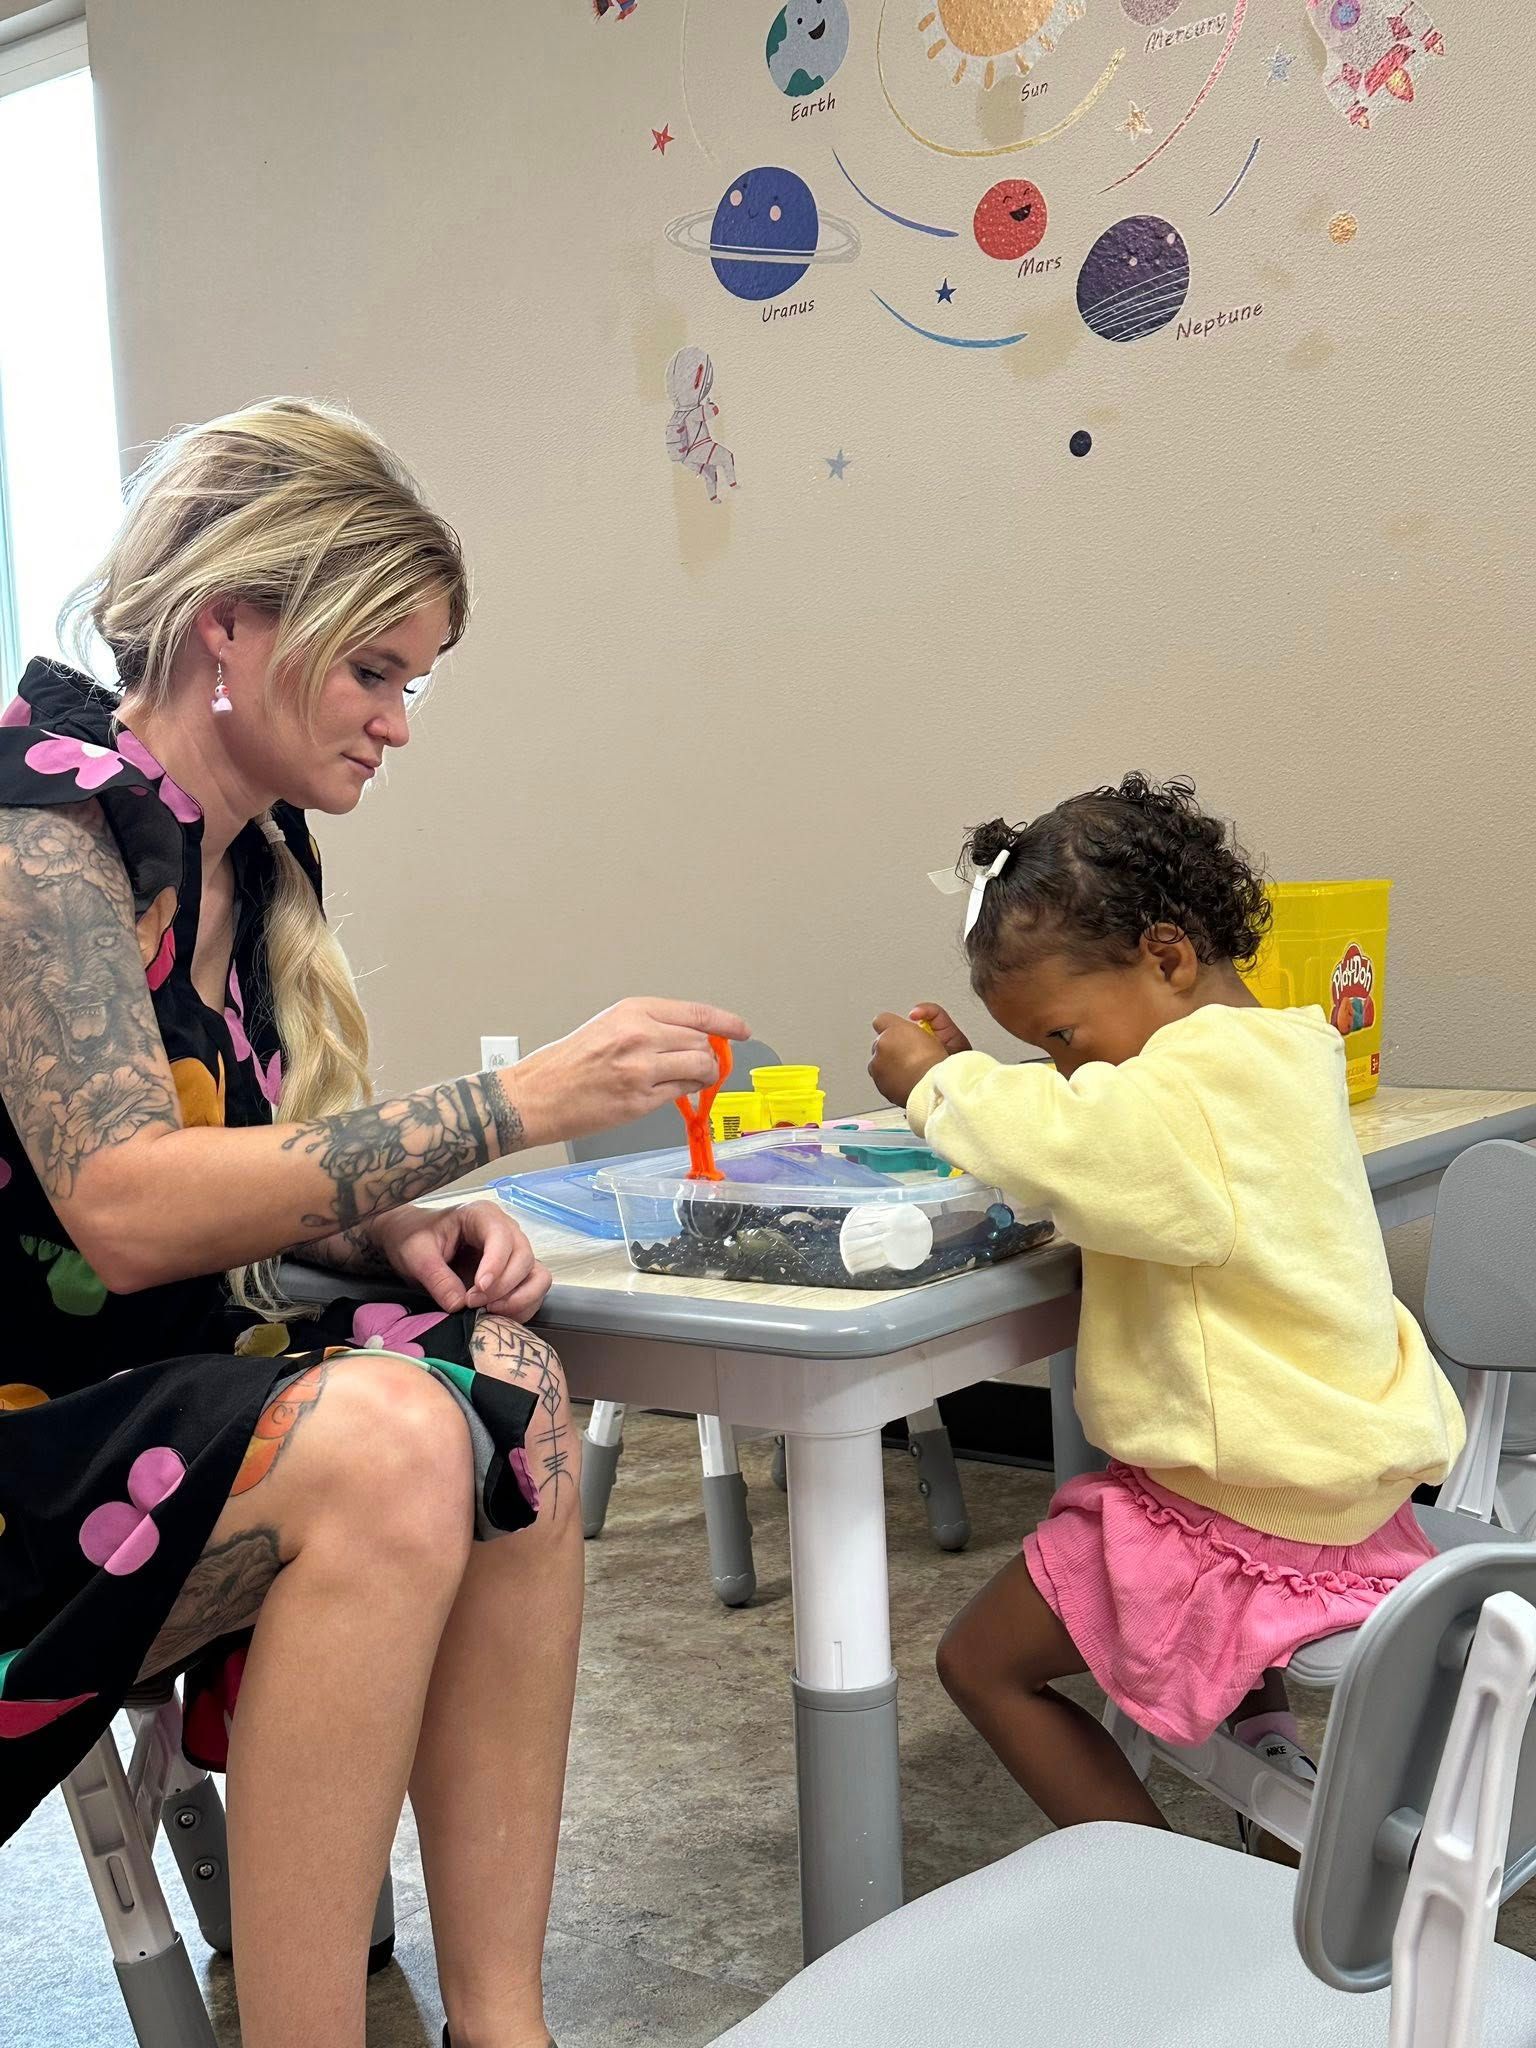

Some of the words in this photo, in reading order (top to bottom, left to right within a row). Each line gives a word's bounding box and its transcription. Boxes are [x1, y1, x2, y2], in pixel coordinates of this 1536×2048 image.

[1144, 14, 1227, 53] Mercury
[1021, 82, 1049, 102] Sun
[791, 92, 836, 122] Earth
[1017, 256, 1062, 279] Mars
[762, 299, 815, 323] Uranus
[1176, 303, 1264, 341] Neptune
